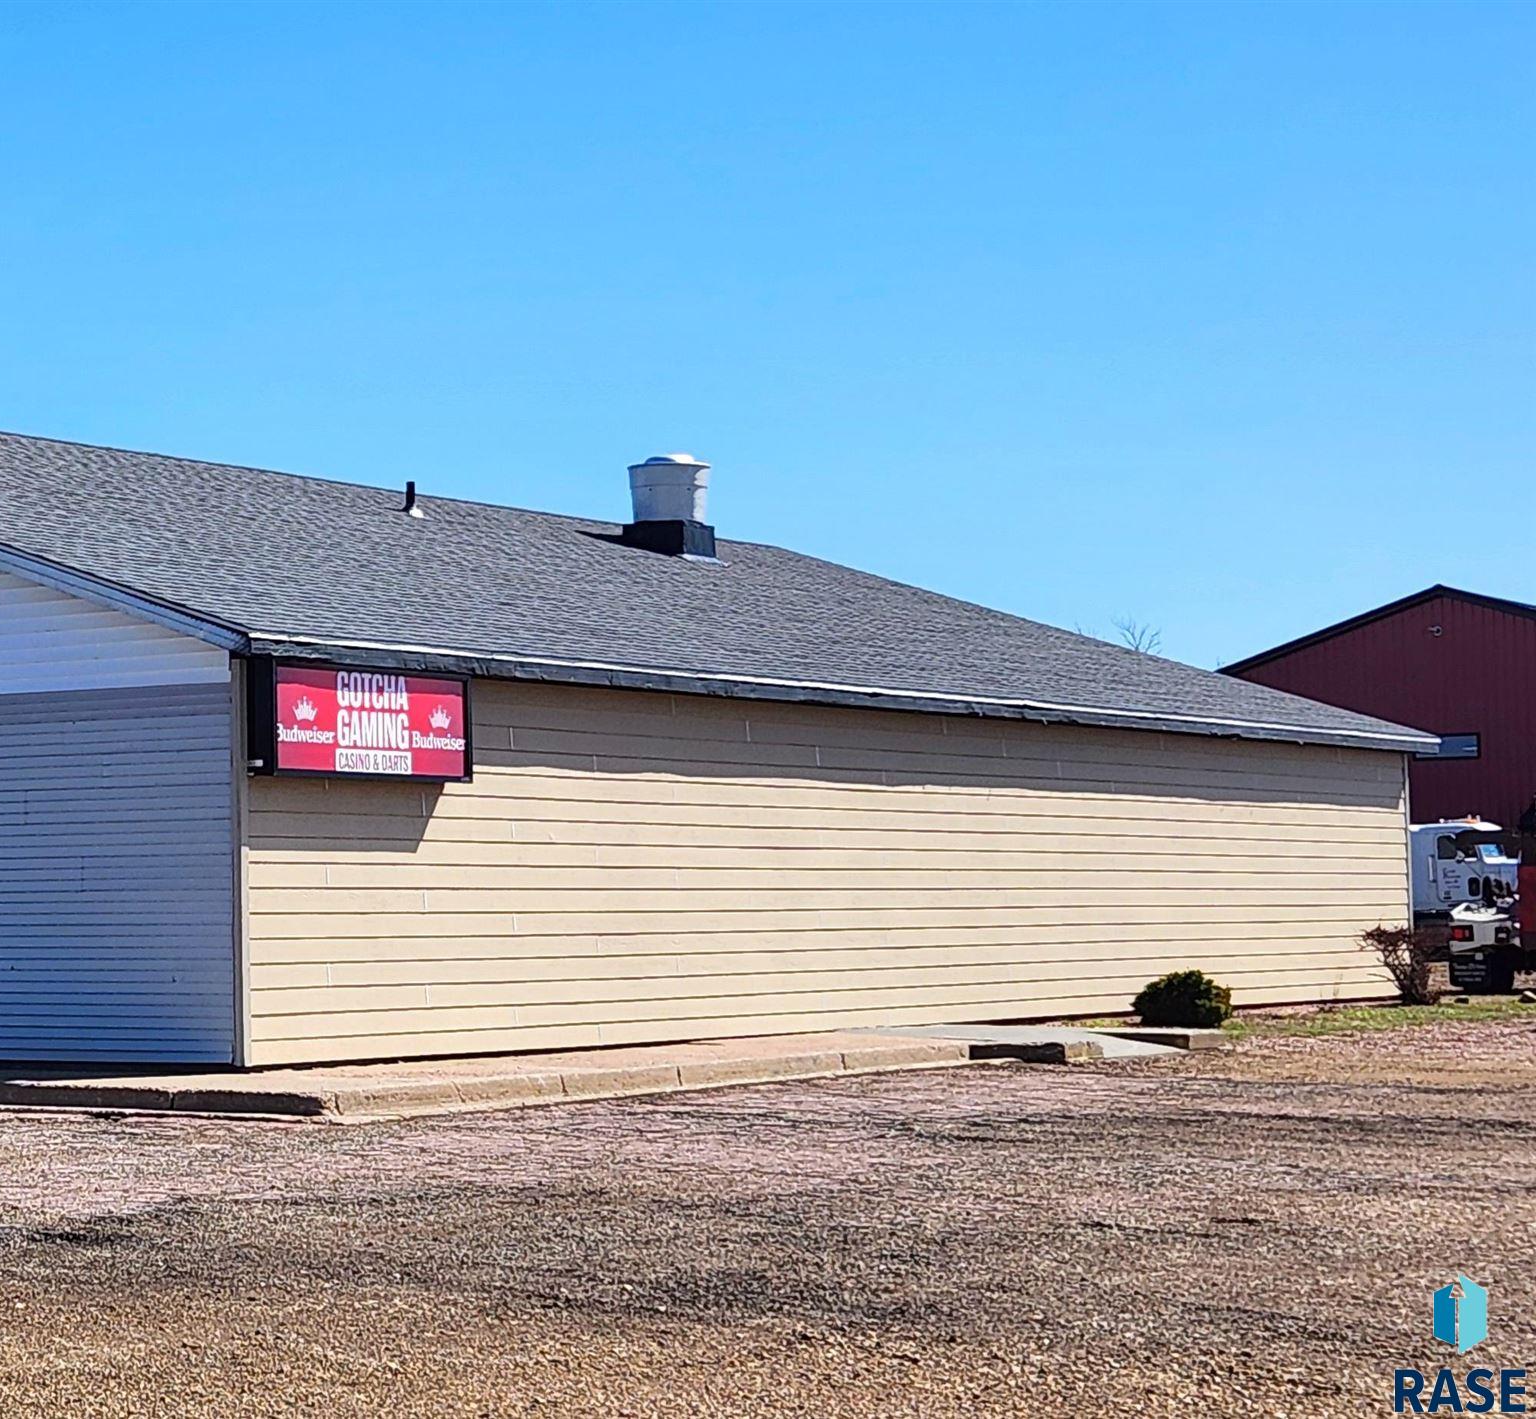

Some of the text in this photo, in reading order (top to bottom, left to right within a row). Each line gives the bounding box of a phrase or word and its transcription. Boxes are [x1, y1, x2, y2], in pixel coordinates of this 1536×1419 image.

[337, 671, 409, 711] GOTCHA
[277, 722, 335, 744] Budweiser
[337, 709, 409, 750] GAMING
[411, 730, 466, 751] Budweiser
[338, 752, 409, 773] CASINO & DARTS
